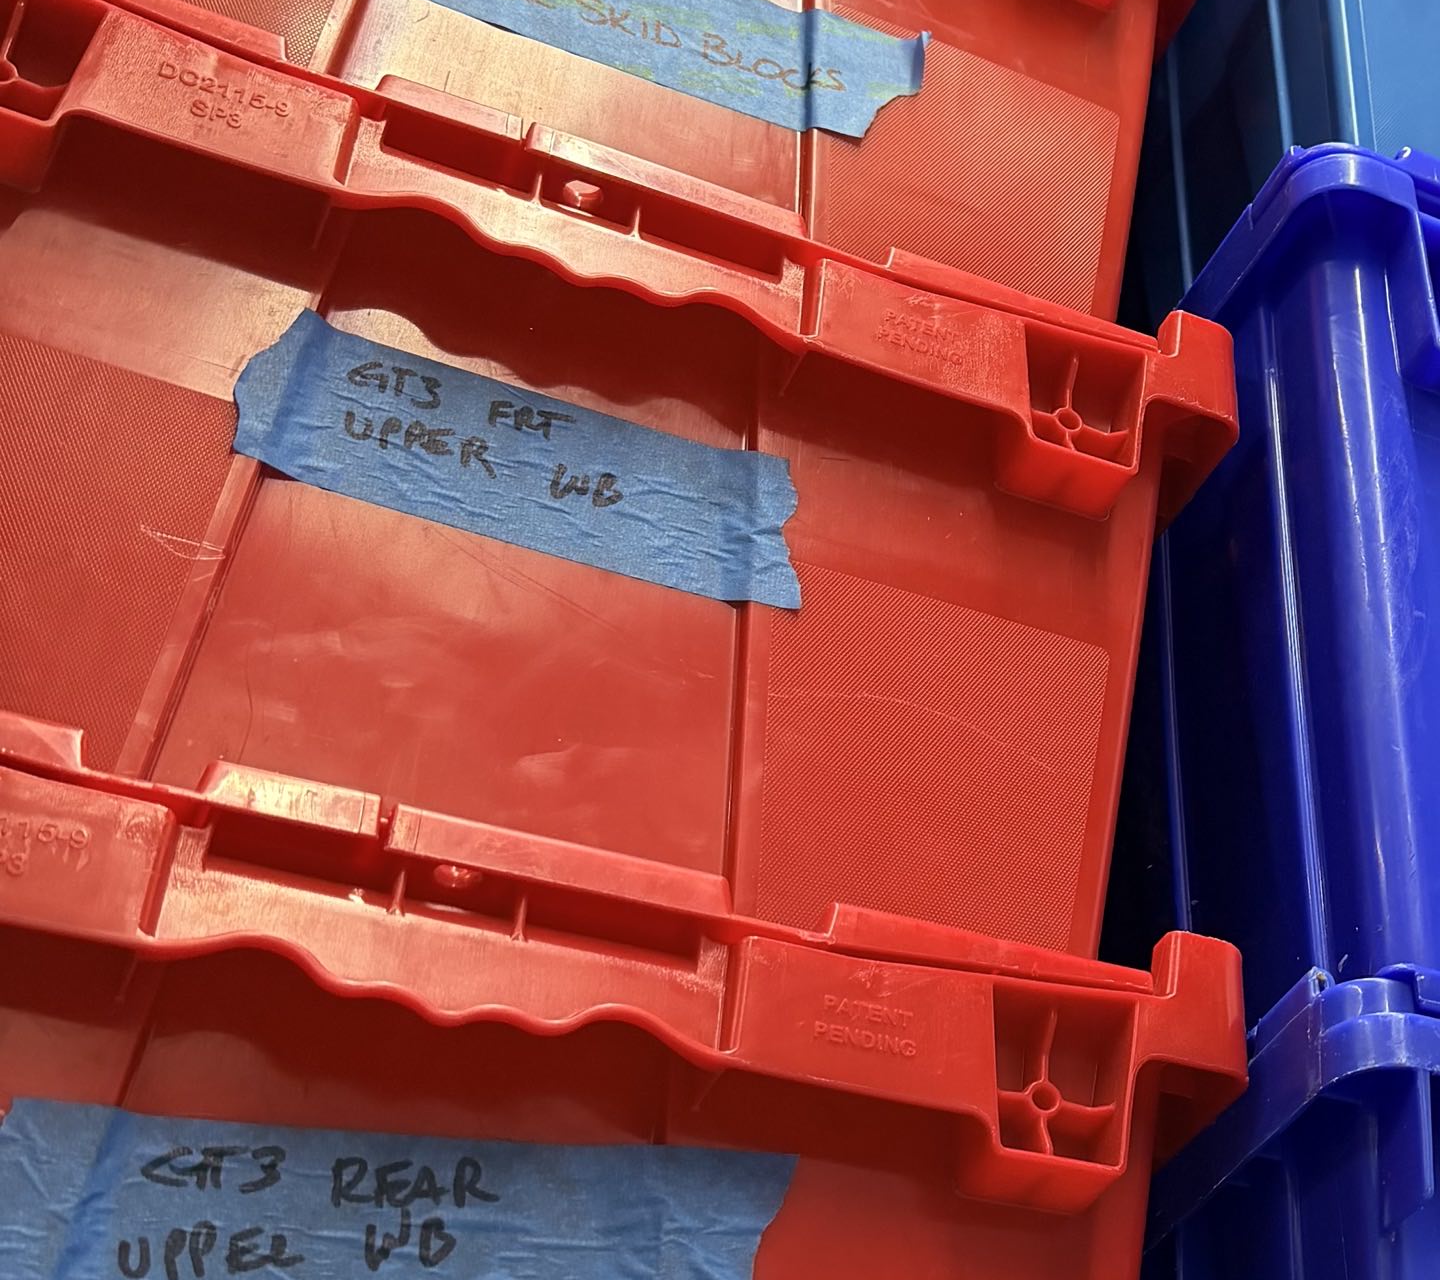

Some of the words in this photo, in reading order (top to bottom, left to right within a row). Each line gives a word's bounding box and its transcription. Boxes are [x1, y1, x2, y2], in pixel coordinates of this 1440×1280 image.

[157, 60, 291, 118] DC2115-9
[347, 361, 442, 409] GT3
[488, 400, 576, 440] FRT
[344, 410, 497, 480] UPPER
[813, 1020, 918, 1058] PENDING
[822, 993, 915, 1028] PATENT
[140, 1145, 287, 1194] GT3
[331, 1156, 501, 1209] REAR
[364, 1207, 456, 1272] WB
